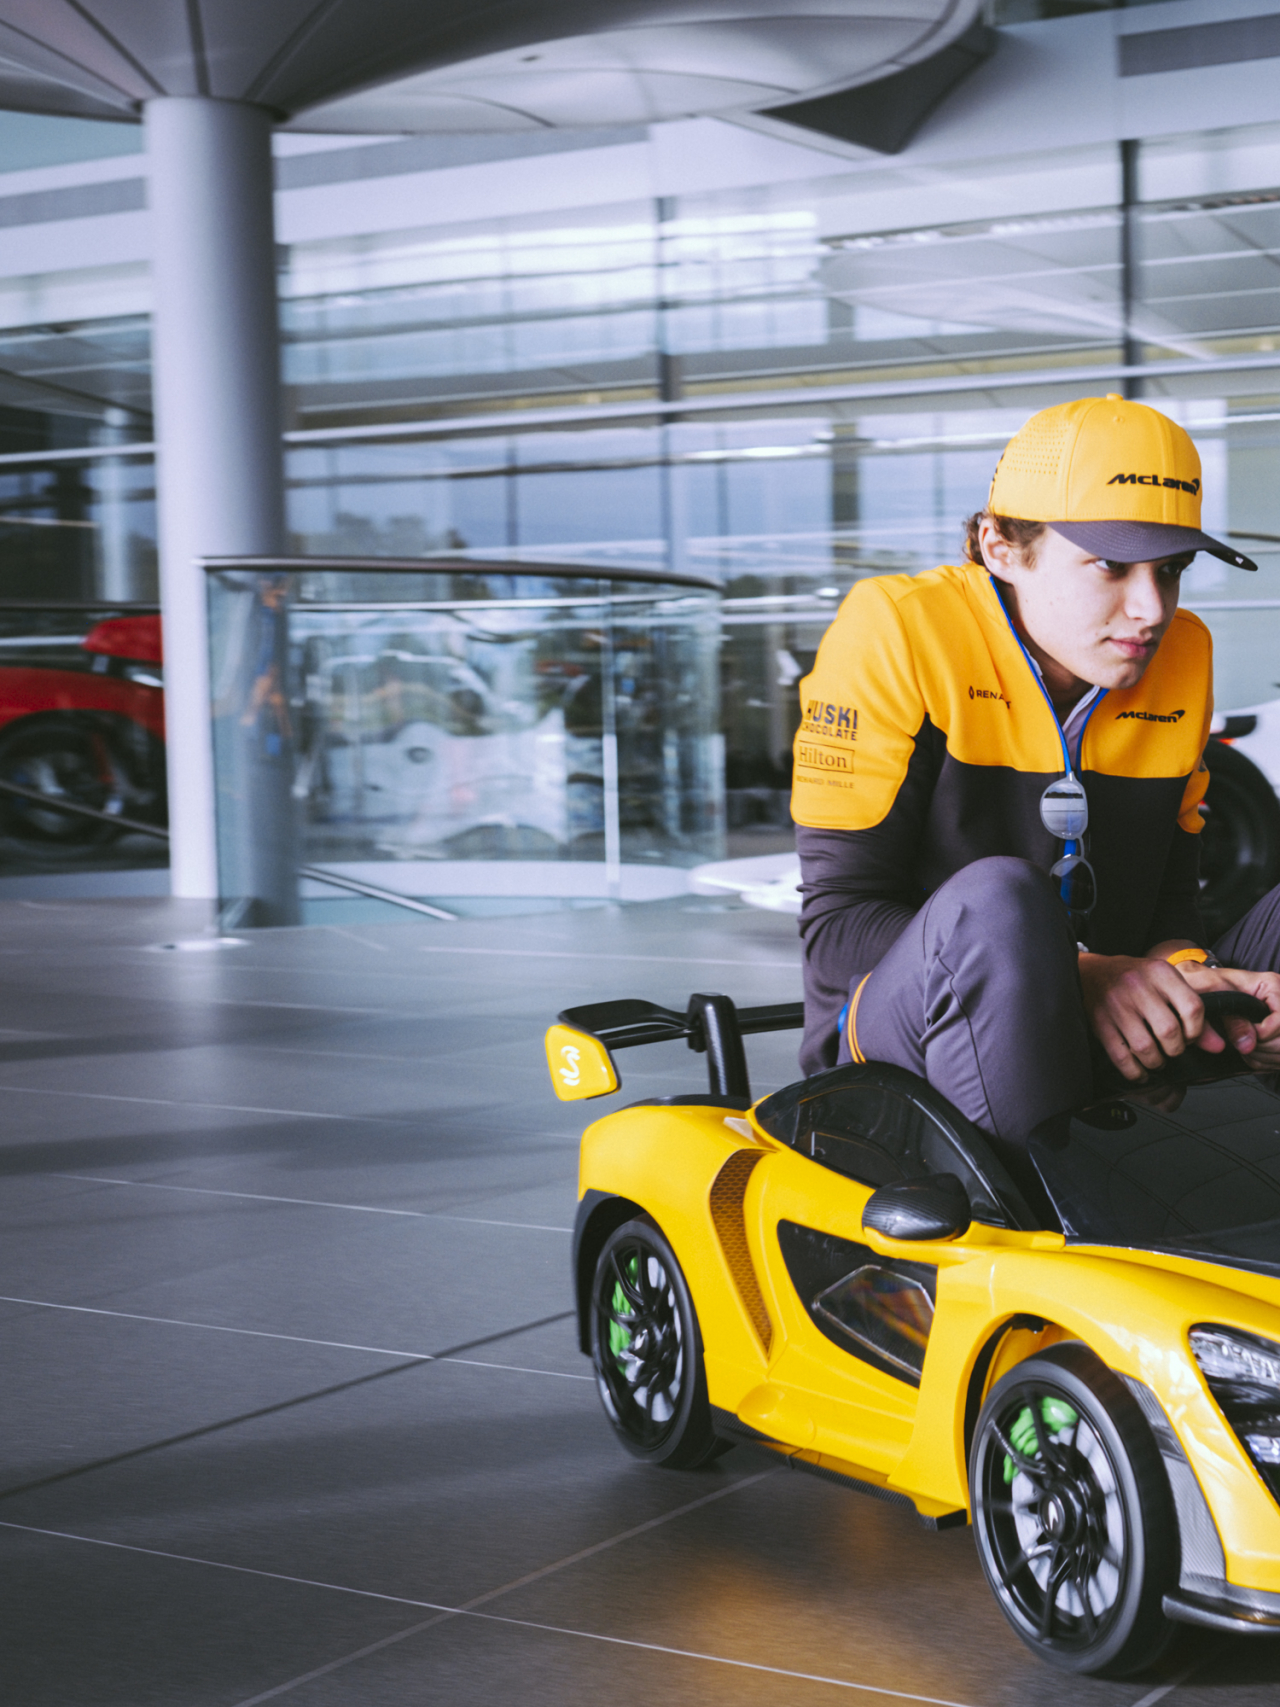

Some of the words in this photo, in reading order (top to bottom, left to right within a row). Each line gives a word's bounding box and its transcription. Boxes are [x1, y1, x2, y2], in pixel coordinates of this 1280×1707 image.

[1106, 473, 1199, 496] McLaren
[976, 689, 1011, 709] RENAT
[1115, 710, 1178, 723] McLaren
[799, 746, 847, 768] Hilton
